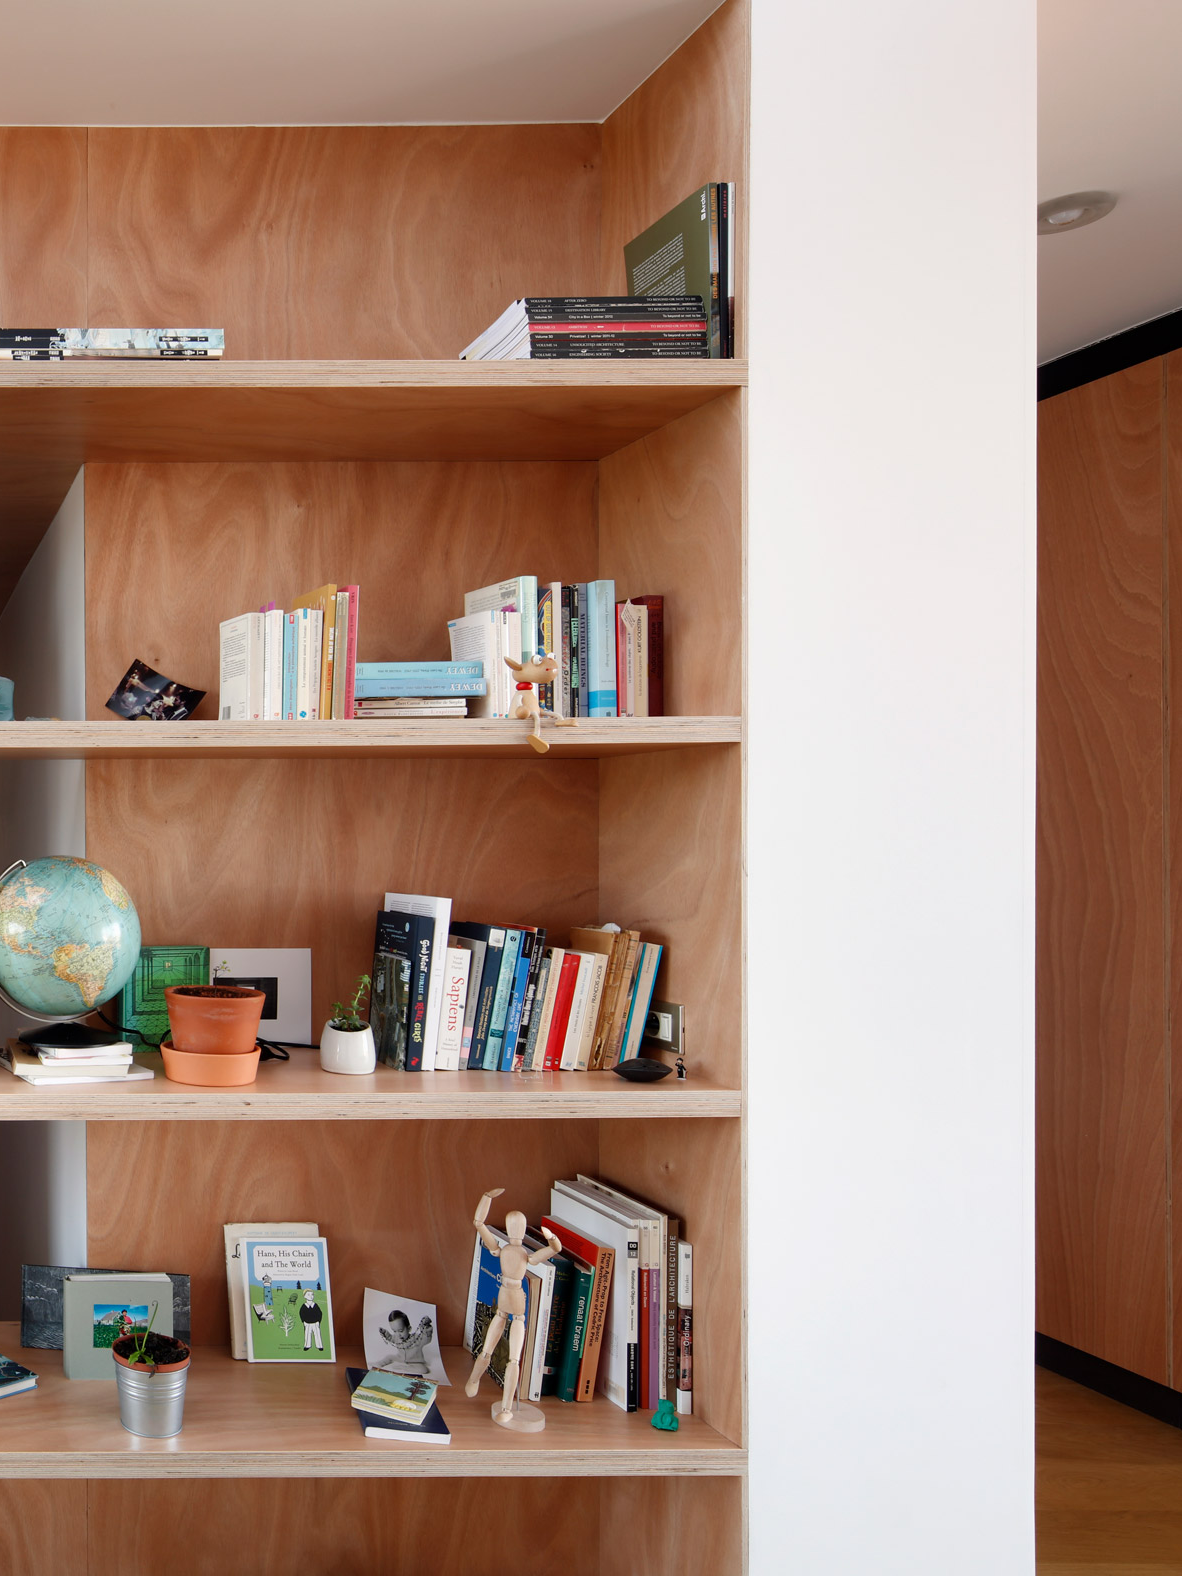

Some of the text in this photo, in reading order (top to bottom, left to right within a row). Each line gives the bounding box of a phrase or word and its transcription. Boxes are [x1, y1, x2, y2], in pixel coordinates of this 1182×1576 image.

[446, 666, 478, 674] DEWEY
[450, 683, 483, 691] DEWEY
[595, 965, 603, 980] JACOB
[446, 976, 464, 1031] Sapiens
[257, 1250, 276, 1258] Hans,
[594, 1265, 605, 1303] Architecture
[600, 1270, 610, 1300] Agit-Prop
[572, 1296, 586, 1352] renaat braem
[669, 1309, 675, 1320] DE
[594, 1323, 602, 1343] Space:
[681, 1315, 691, 1346] Ordinary
[666, 1325, 675, 1379] ESTHÉTIQUE
